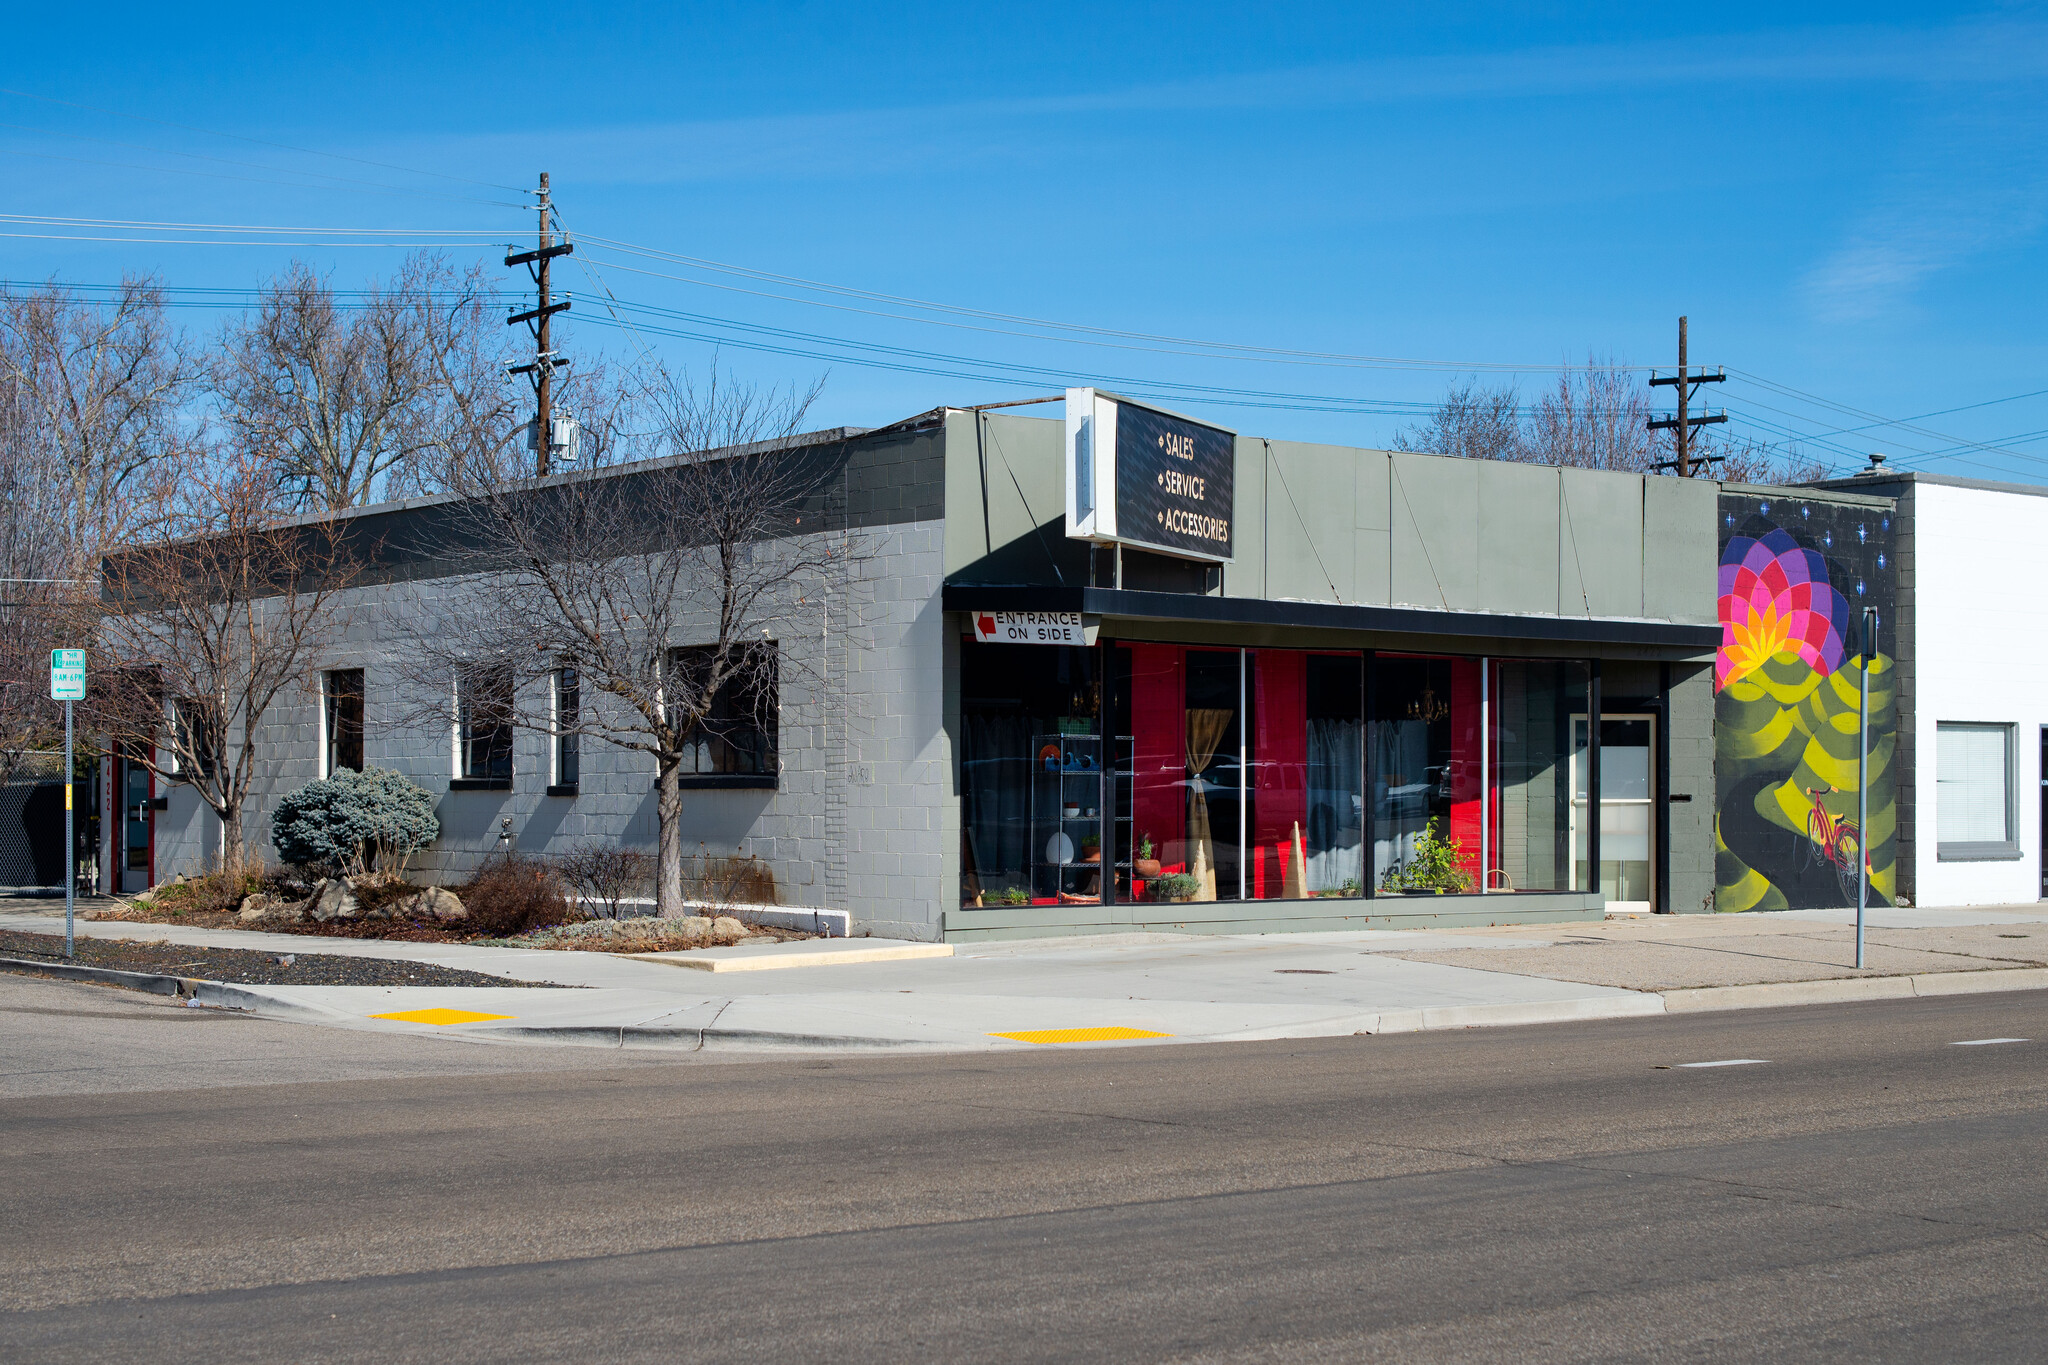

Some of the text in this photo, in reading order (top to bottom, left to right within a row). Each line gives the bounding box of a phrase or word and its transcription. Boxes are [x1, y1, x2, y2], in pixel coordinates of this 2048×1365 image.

[1166, 432, 1194, 461] SALES
[1165, 470, 1205, 500] SERVICE
[1165, 508, 1228, 542] ACCESSORIES
[996, 612, 1079, 625] ENTRANCE
[1008, 628, 1071, 640] ON SIDE
